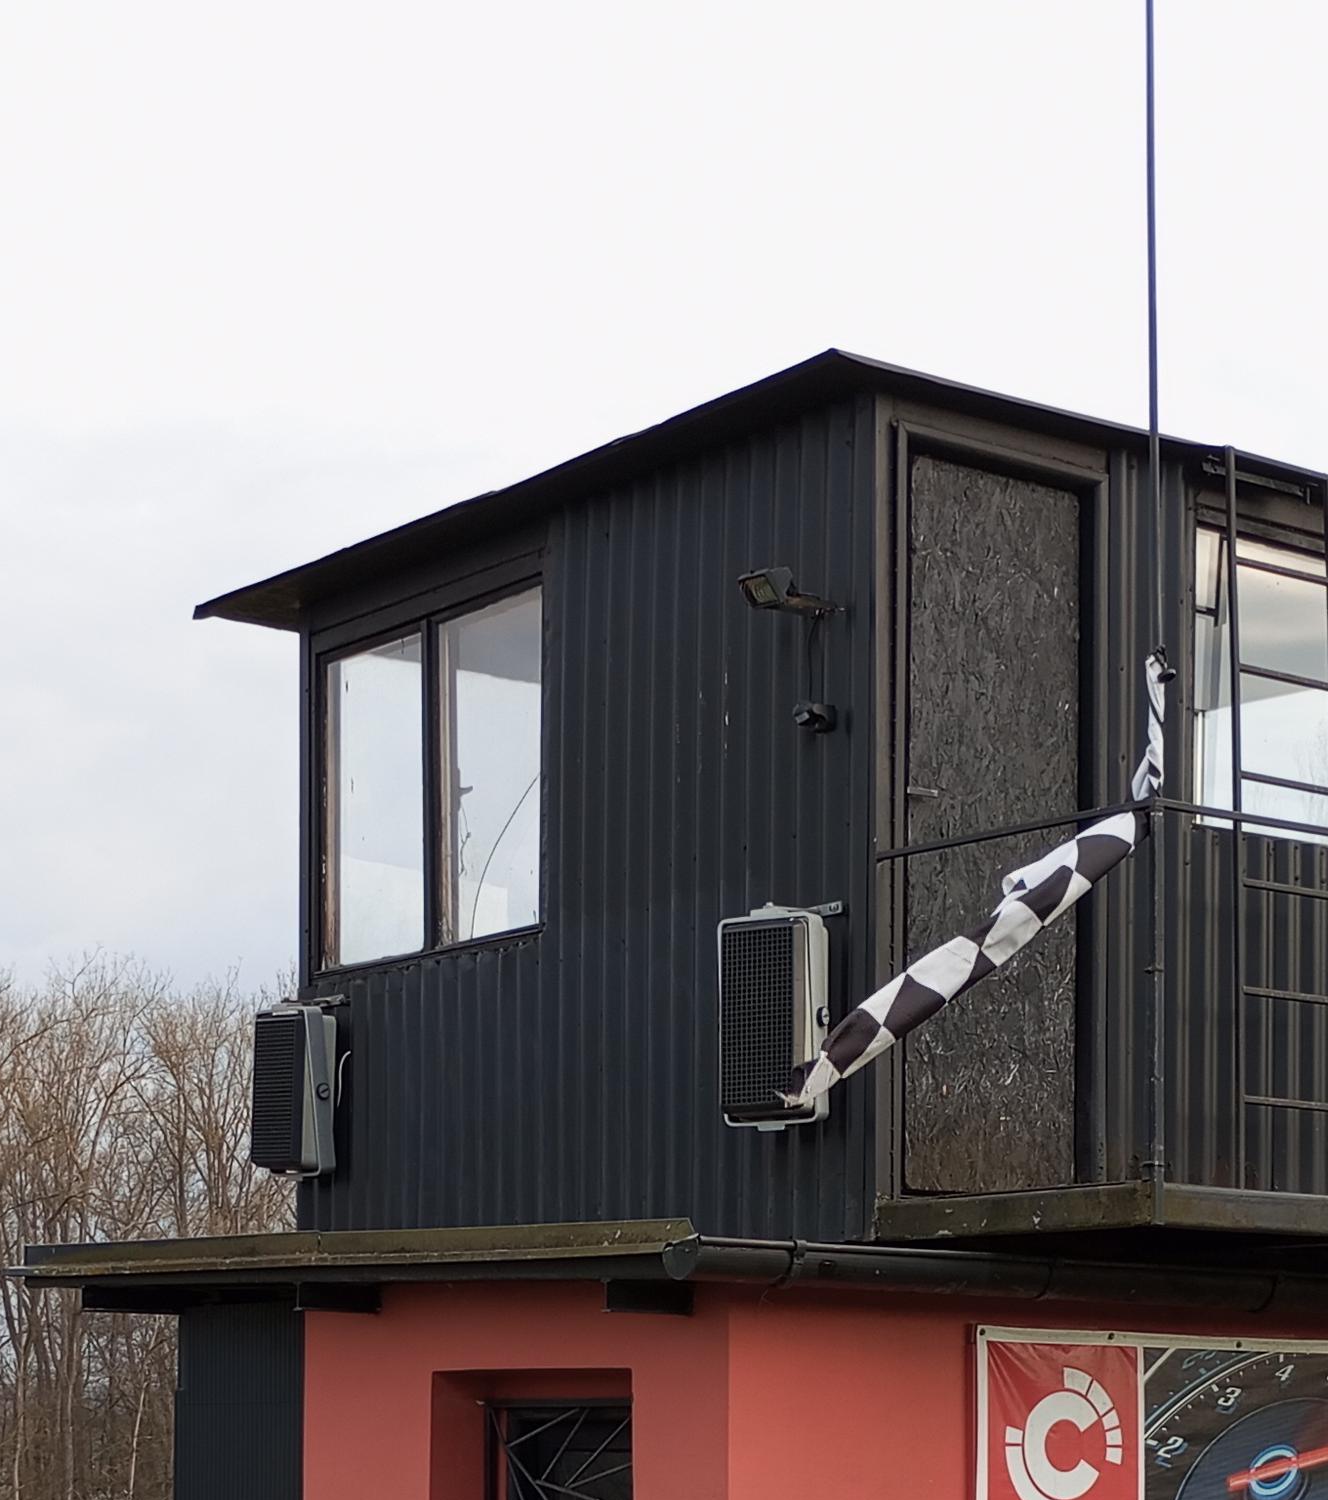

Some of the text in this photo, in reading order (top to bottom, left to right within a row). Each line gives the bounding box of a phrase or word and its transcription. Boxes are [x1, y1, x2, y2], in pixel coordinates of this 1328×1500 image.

[1158, 1436, 1185, 1458] 2
[1217, 1386, 1243, 1407] 3
[1275, 1364, 1295, 1382] 4
